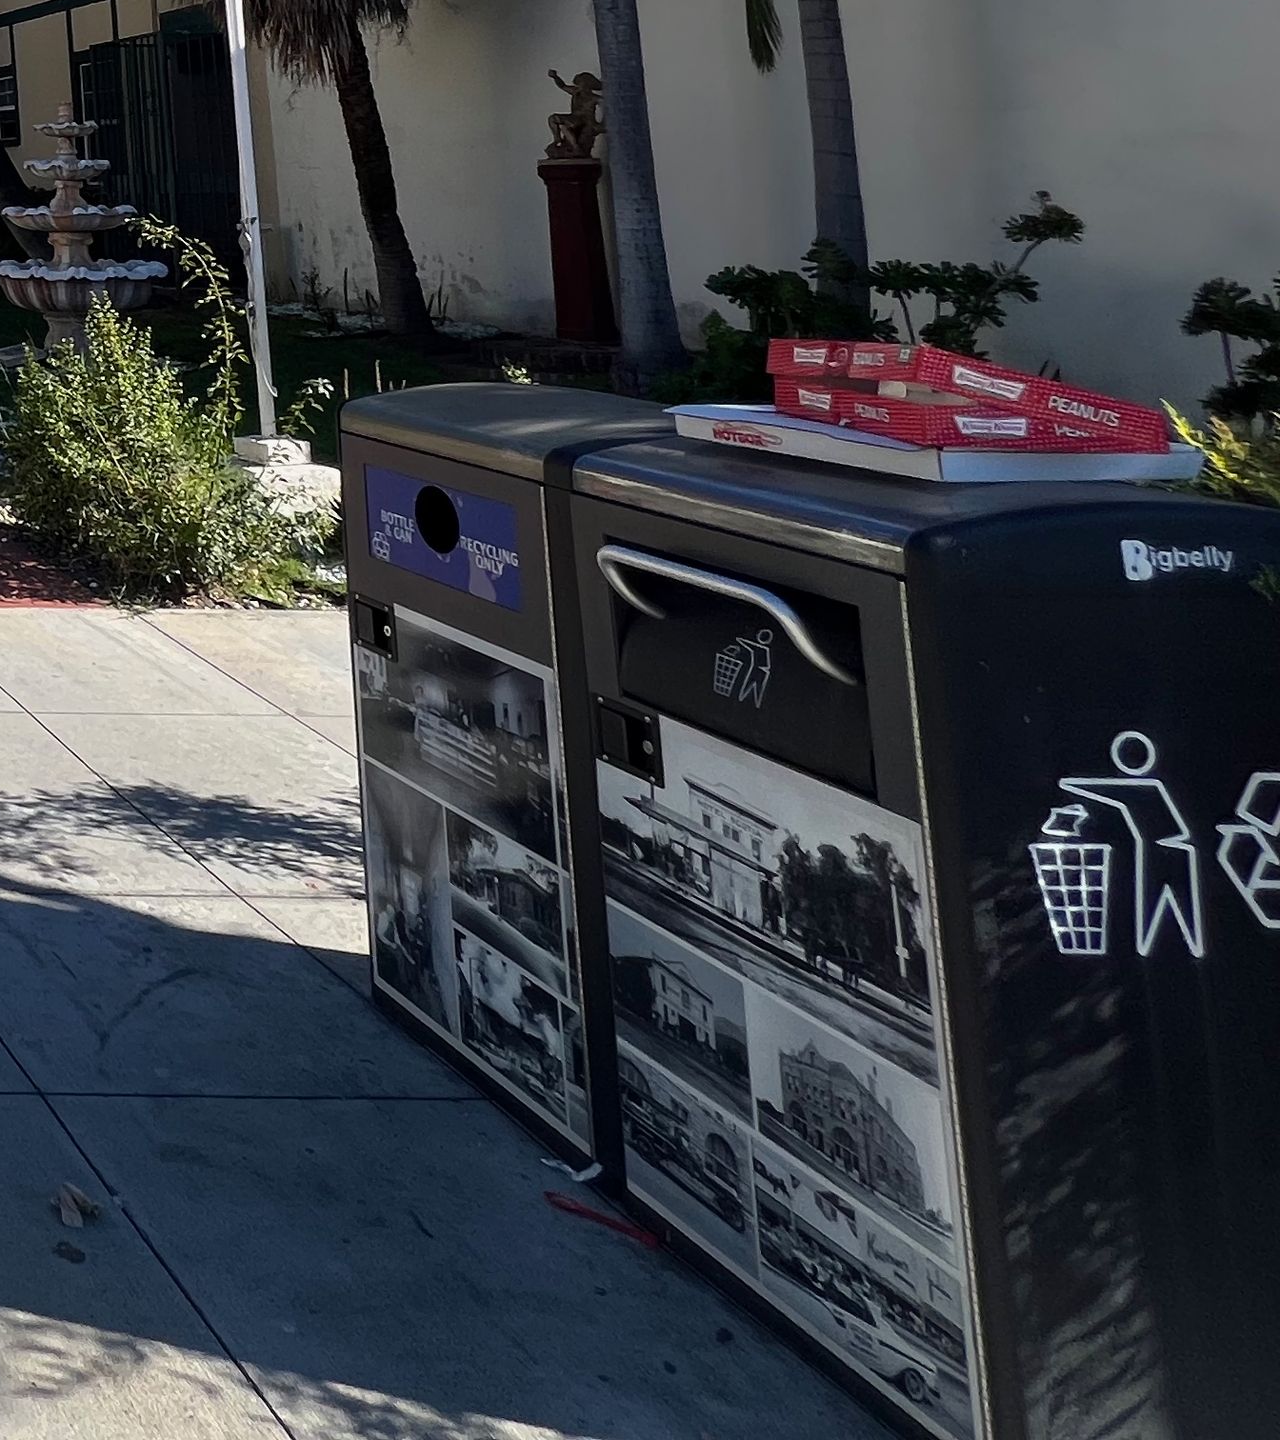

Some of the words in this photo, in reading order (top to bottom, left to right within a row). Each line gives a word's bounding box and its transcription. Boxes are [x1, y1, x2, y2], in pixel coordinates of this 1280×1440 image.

[1048, 395, 1121, 427] PEANUTS
[380, 509, 415, 533] BOTTLE
[384, 523, 393, 537] &
[393, 526, 413, 544] CAN
[460, 535, 519, 567] RECYCLING
[475, 554, 505, 576] ONLY
[1120, 539, 1233, 581] Bigbelly
